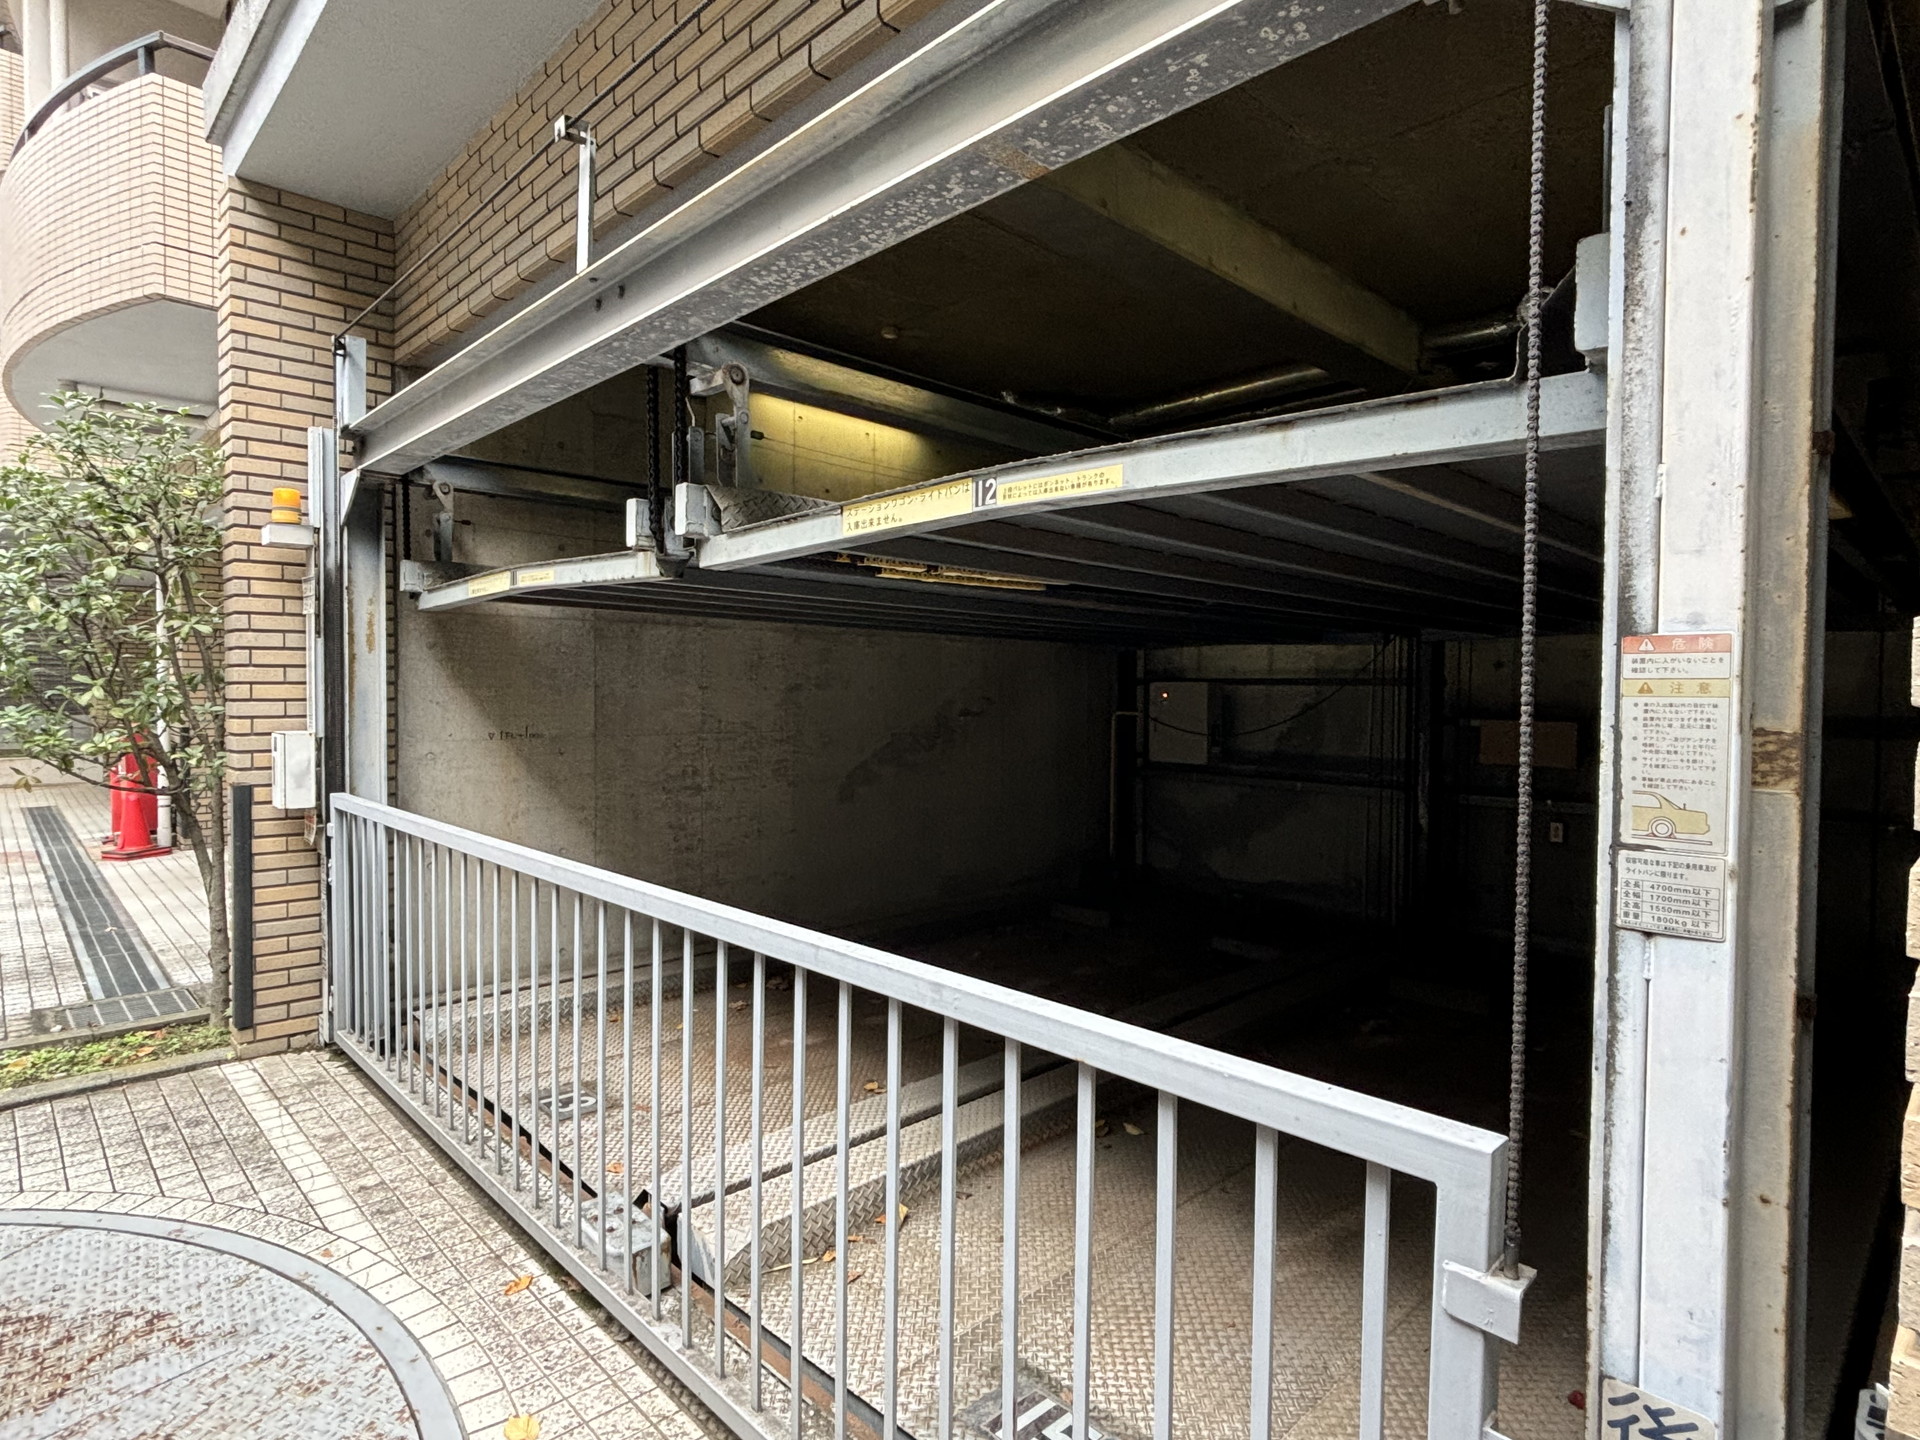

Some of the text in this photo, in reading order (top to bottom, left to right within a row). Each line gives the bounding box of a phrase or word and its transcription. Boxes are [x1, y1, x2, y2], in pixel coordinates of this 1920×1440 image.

[978, 478, 997, 507] 12
[847, 514, 903, 532] 入庫出来ません。
[1671, 636, 1714, 650] 危険
[1631, 666, 1689, 674] 確認して下さい。
[1669, 681, 1711, 694] 注意
[1623, 880, 1641, 889] 全長
[1623, 890, 1641, 899] 全幅
[1623, 900, 1641, 909] 全高
[1623, 911, 1640, 920] 重量
